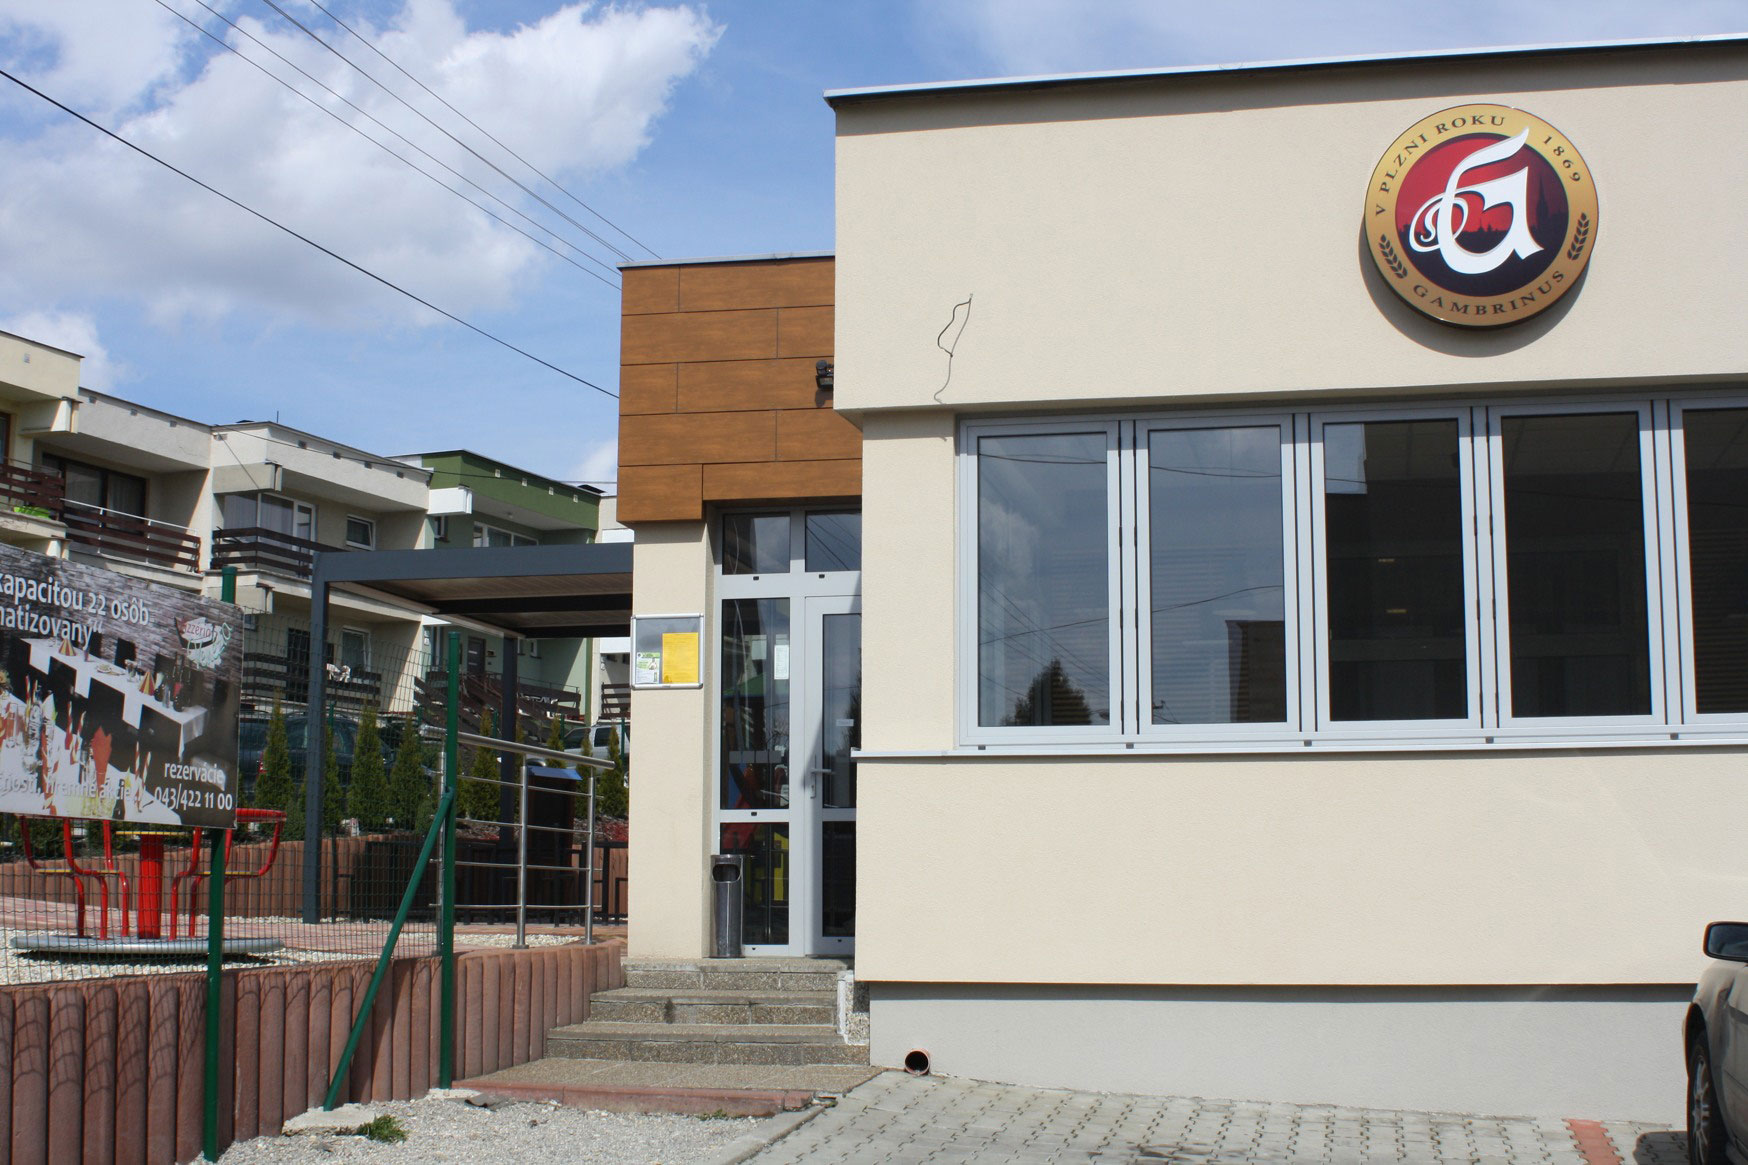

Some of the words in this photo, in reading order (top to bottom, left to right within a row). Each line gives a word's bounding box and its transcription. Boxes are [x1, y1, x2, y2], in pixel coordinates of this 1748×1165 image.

[1435, 114, 1507, 135] ROKU
[1379, 133, 1429, 194] PLZNI
[1542, 135, 1581, 182] 1869
[1375, 206, 1386, 216] V
[1413, 269, 1565, 315] GAMBRINUS
[88, 592, 106, 616] 22
[111, 597, 149, 626] osôb
[164, 762, 225, 784] rezervácie
[154, 783, 201, 811] 043/422
[205, 791, 214, 809] 11
[217, 792, 233, 811] 00
